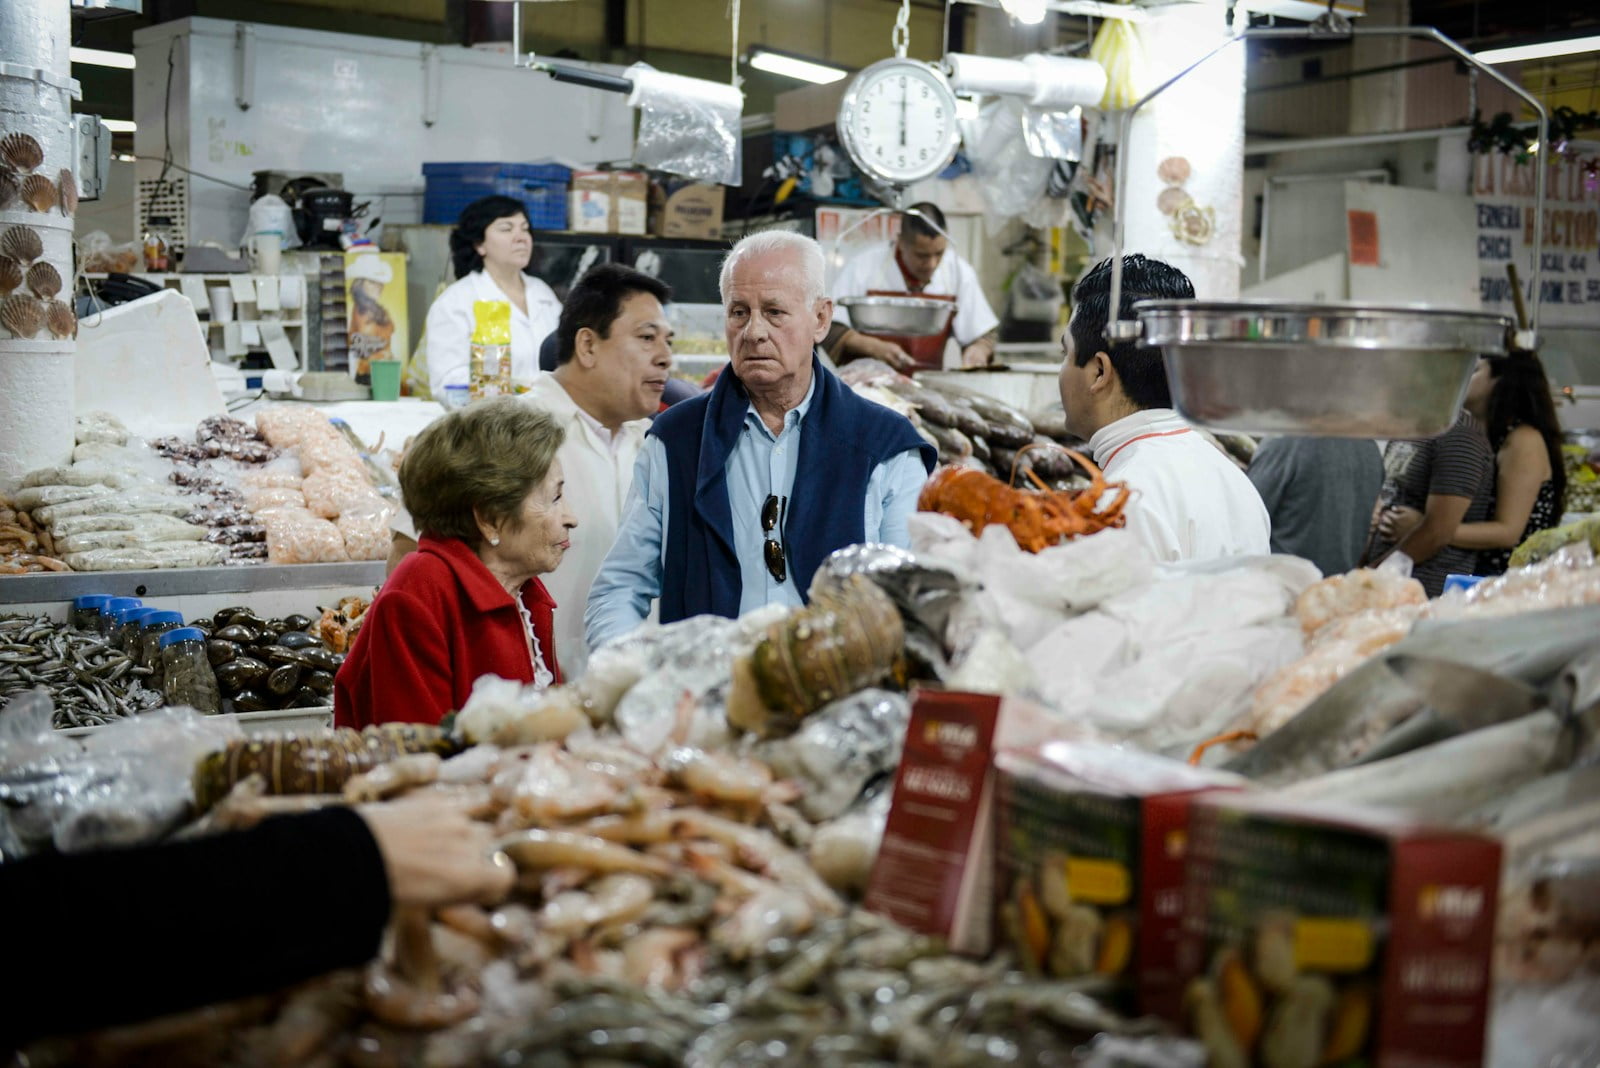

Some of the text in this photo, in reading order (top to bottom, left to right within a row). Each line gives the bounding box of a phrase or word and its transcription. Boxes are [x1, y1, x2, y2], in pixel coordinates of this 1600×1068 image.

[878, 82, 884, 94] 1
[863, 101, 870, 113] 2
[876, 146, 882, 157] 4
[898, 155, 905, 168] 5
[1475, 203, 1521, 229] ERNERA
